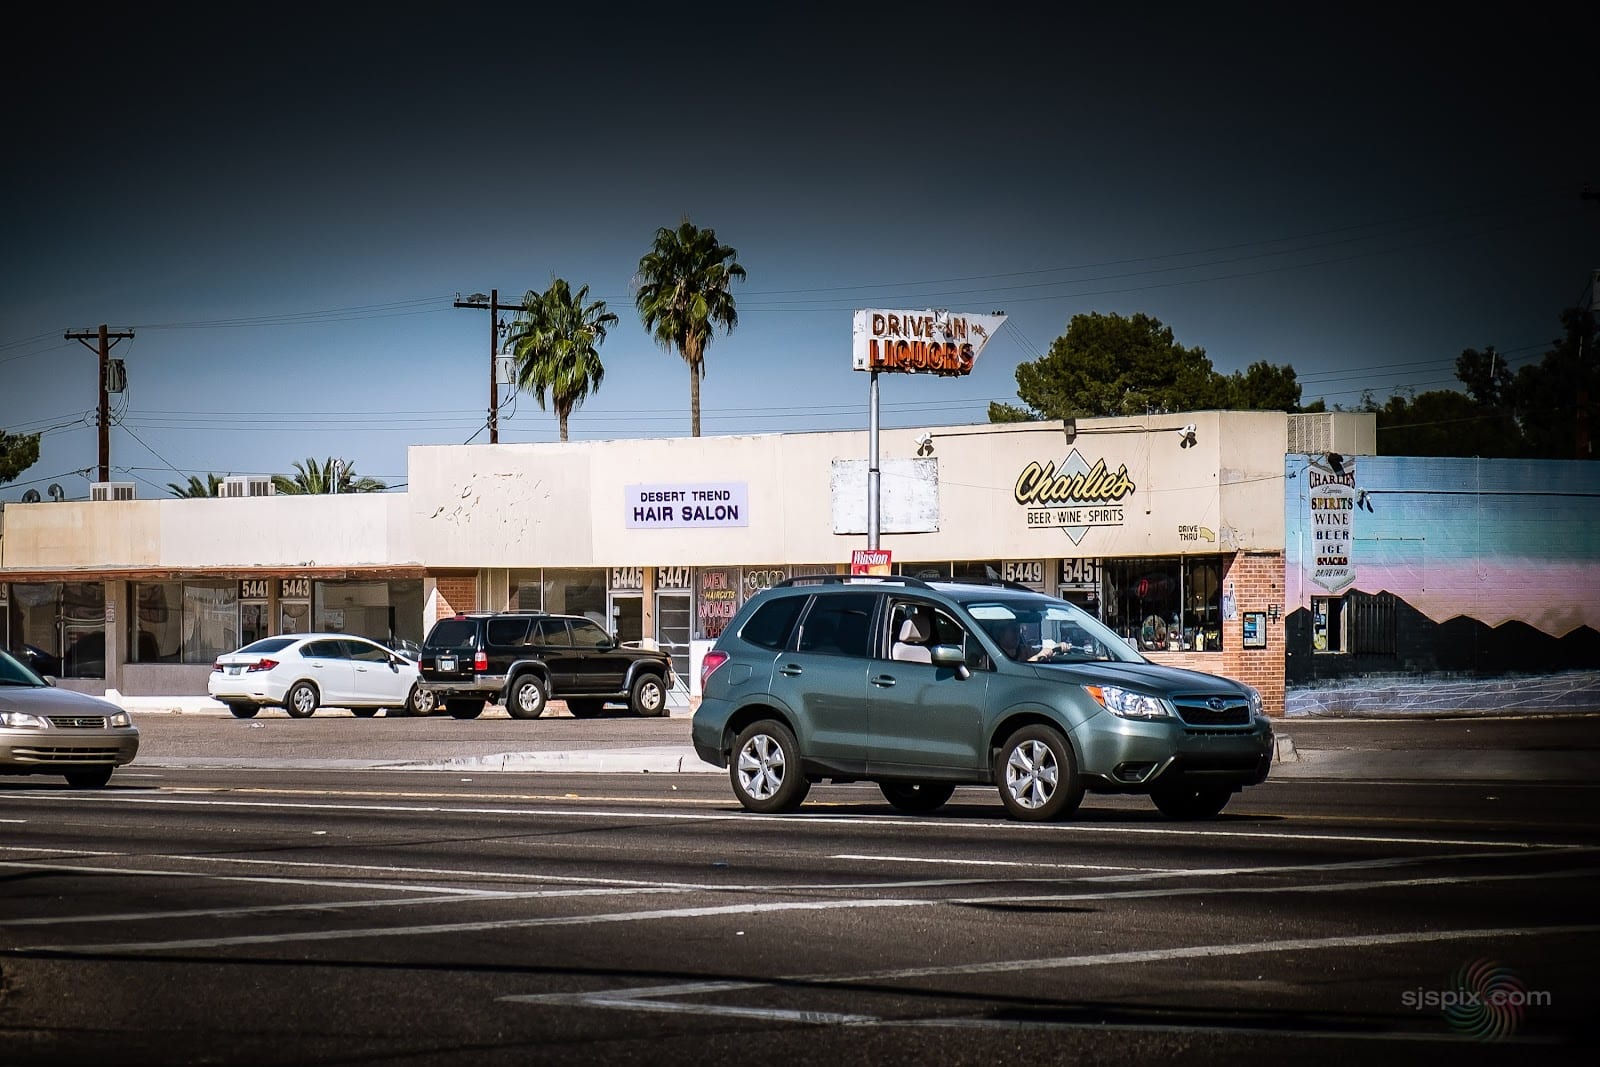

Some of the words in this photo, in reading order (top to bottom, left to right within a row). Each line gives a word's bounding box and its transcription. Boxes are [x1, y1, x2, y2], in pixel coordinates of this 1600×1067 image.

[873, 314, 935, 337] DRIVE
[869, 340, 974, 371] LIQUORS
[1015, 457, 1135, 505] Charlie's
[640, 491, 686, 502] DESERT
[692, 490, 731, 501] TREND
[1311, 497, 1354, 510] SPIRITS
[633, 506, 674, 522] HAIR
[681, 505, 739, 521] SALON
[1027, 512, 1051, 524] BEER
[1057, 511, 1082, 523] WINE
[1088, 509, 1124, 522] SPIRITS
[1315, 513, 1348, 525] WINE
[1178, 525, 1198, 533] DRIVE
[1179, 533, 1198, 541] THRU
[1316, 530, 1349, 540] BEER
[854, 551, 888, 565] Winston
[1322, 545, 1343, 554] ICE
[613, 566, 643, 589] 5445
[658, 566, 690, 589] 5447
[703, 572, 727, 589] MEN
[1007, 562, 1042, 582] 5449
[242, 580, 268, 597] 5441
[282, 579, 310, 597] 5443
[704, 590, 737, 600] HAIRCUTS
[698, 600, 737, 618] WOMEN
